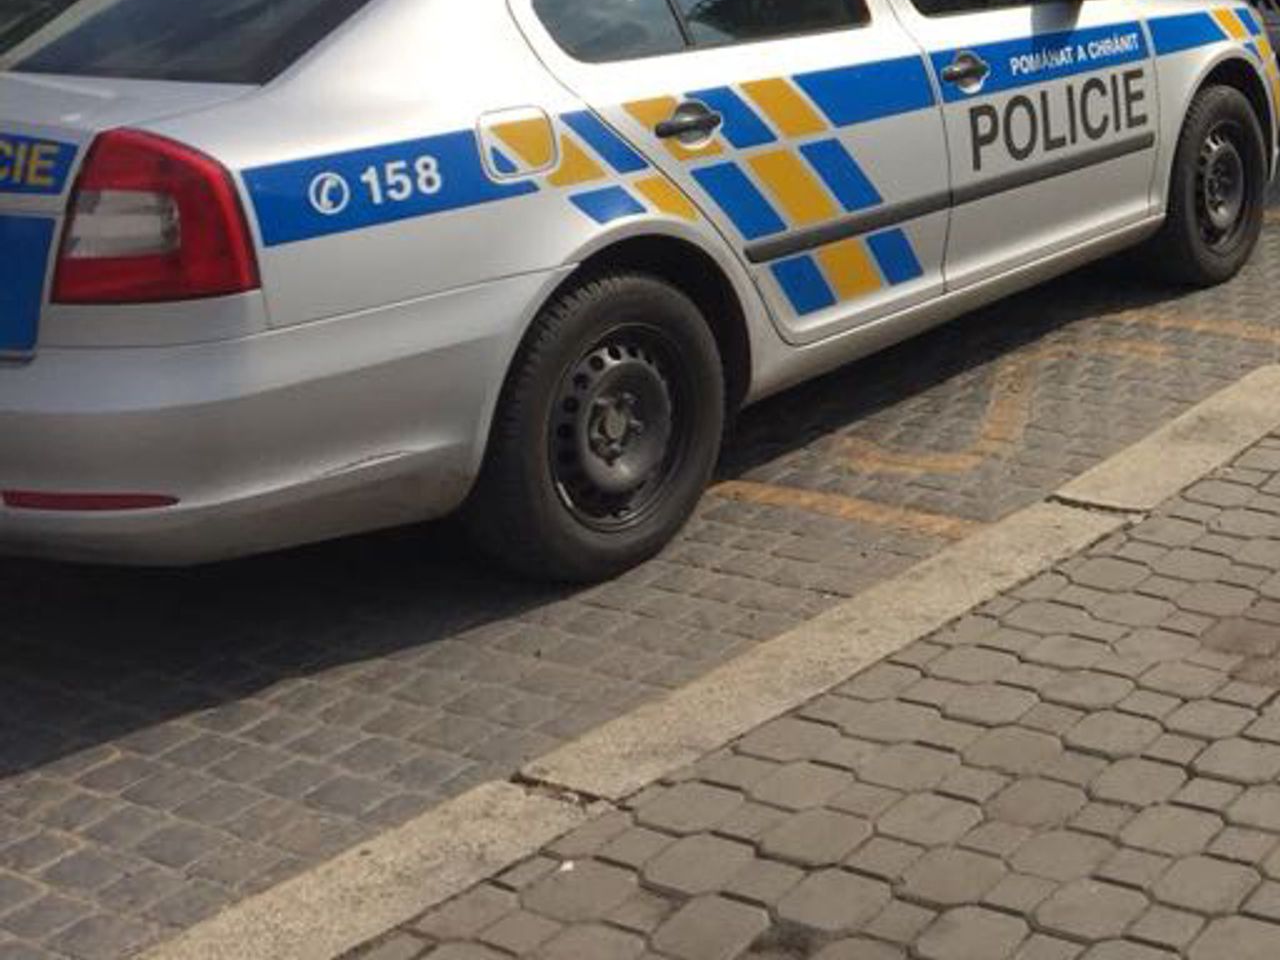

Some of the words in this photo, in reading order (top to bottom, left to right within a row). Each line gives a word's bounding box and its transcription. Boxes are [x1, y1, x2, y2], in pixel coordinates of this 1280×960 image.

[1077, 44, 1088, 62] A
[969, 68, 1148, 172] POLICIE
[360, 154, 442, 205] 158
